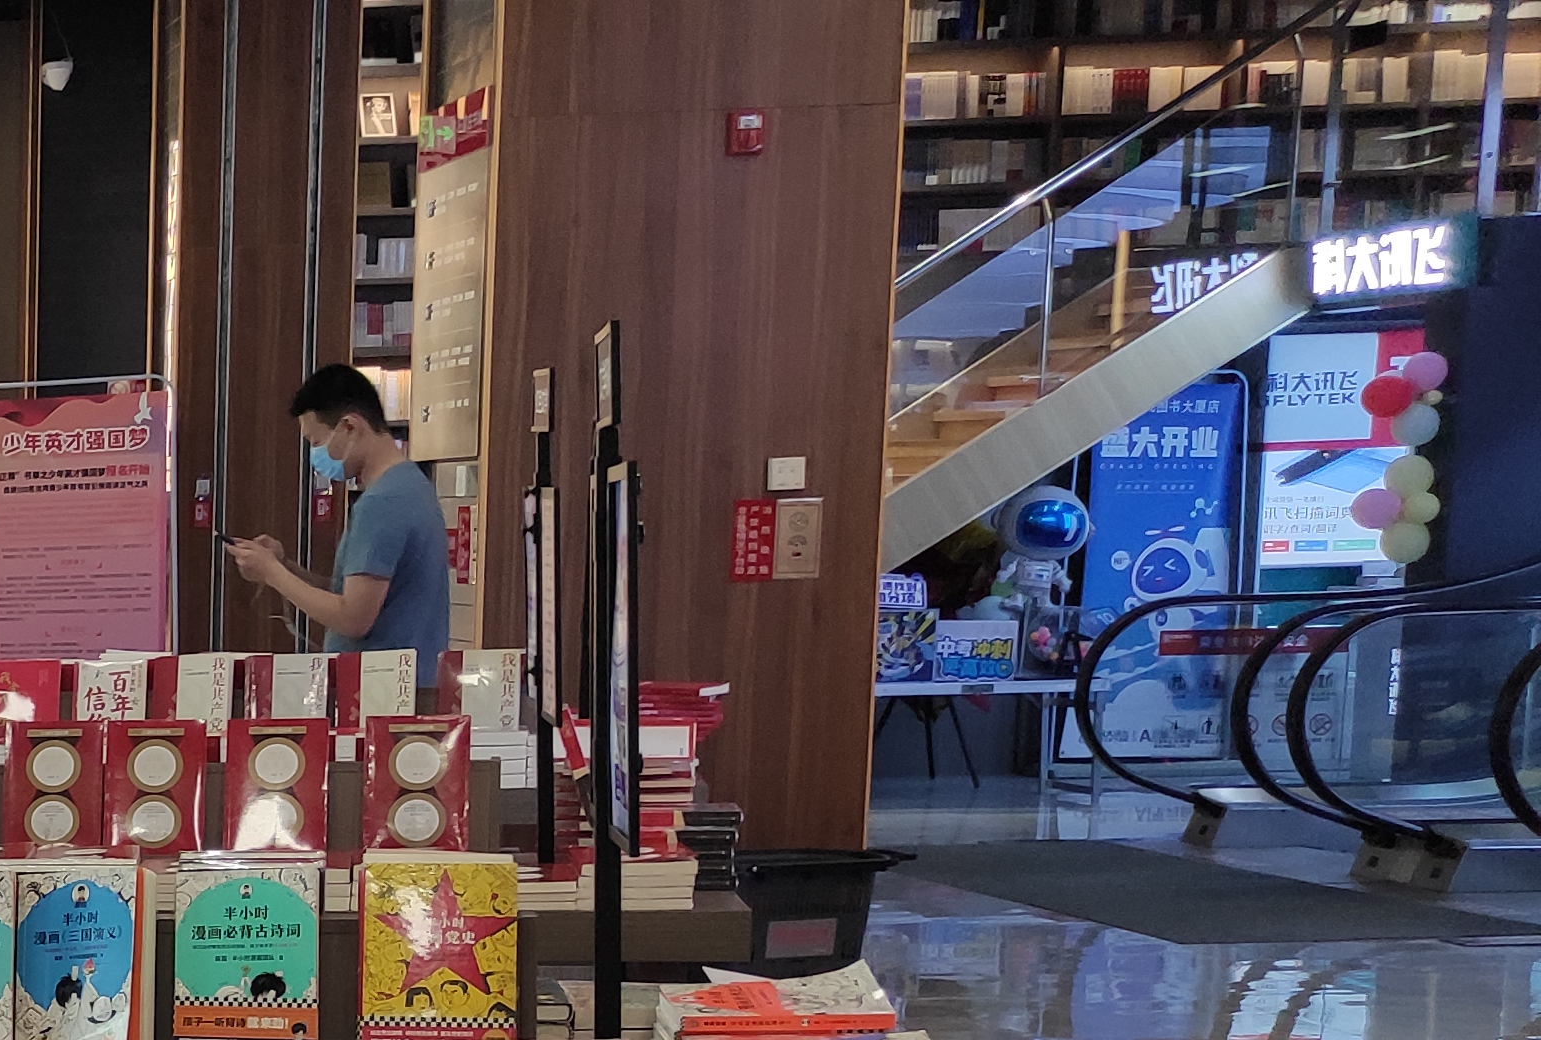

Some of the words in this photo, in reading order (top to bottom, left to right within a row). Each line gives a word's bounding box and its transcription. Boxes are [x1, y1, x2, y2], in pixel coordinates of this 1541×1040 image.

[1312, 224, 1448, 294] 科大讯飞
[1267, 371, 1359, 392] 科大讯飞
[2, 426, 149, 456] 少年英才强国梦
[1101, 427, 1219, 458] 盛大开业
[937, 636, 1012, 660] 中考冲刺
[63, 910, 99, 926] 半小时
[223, 906, 269, 921] 半小时
[191, 923, 302, 941] 漫画必背古诗词
